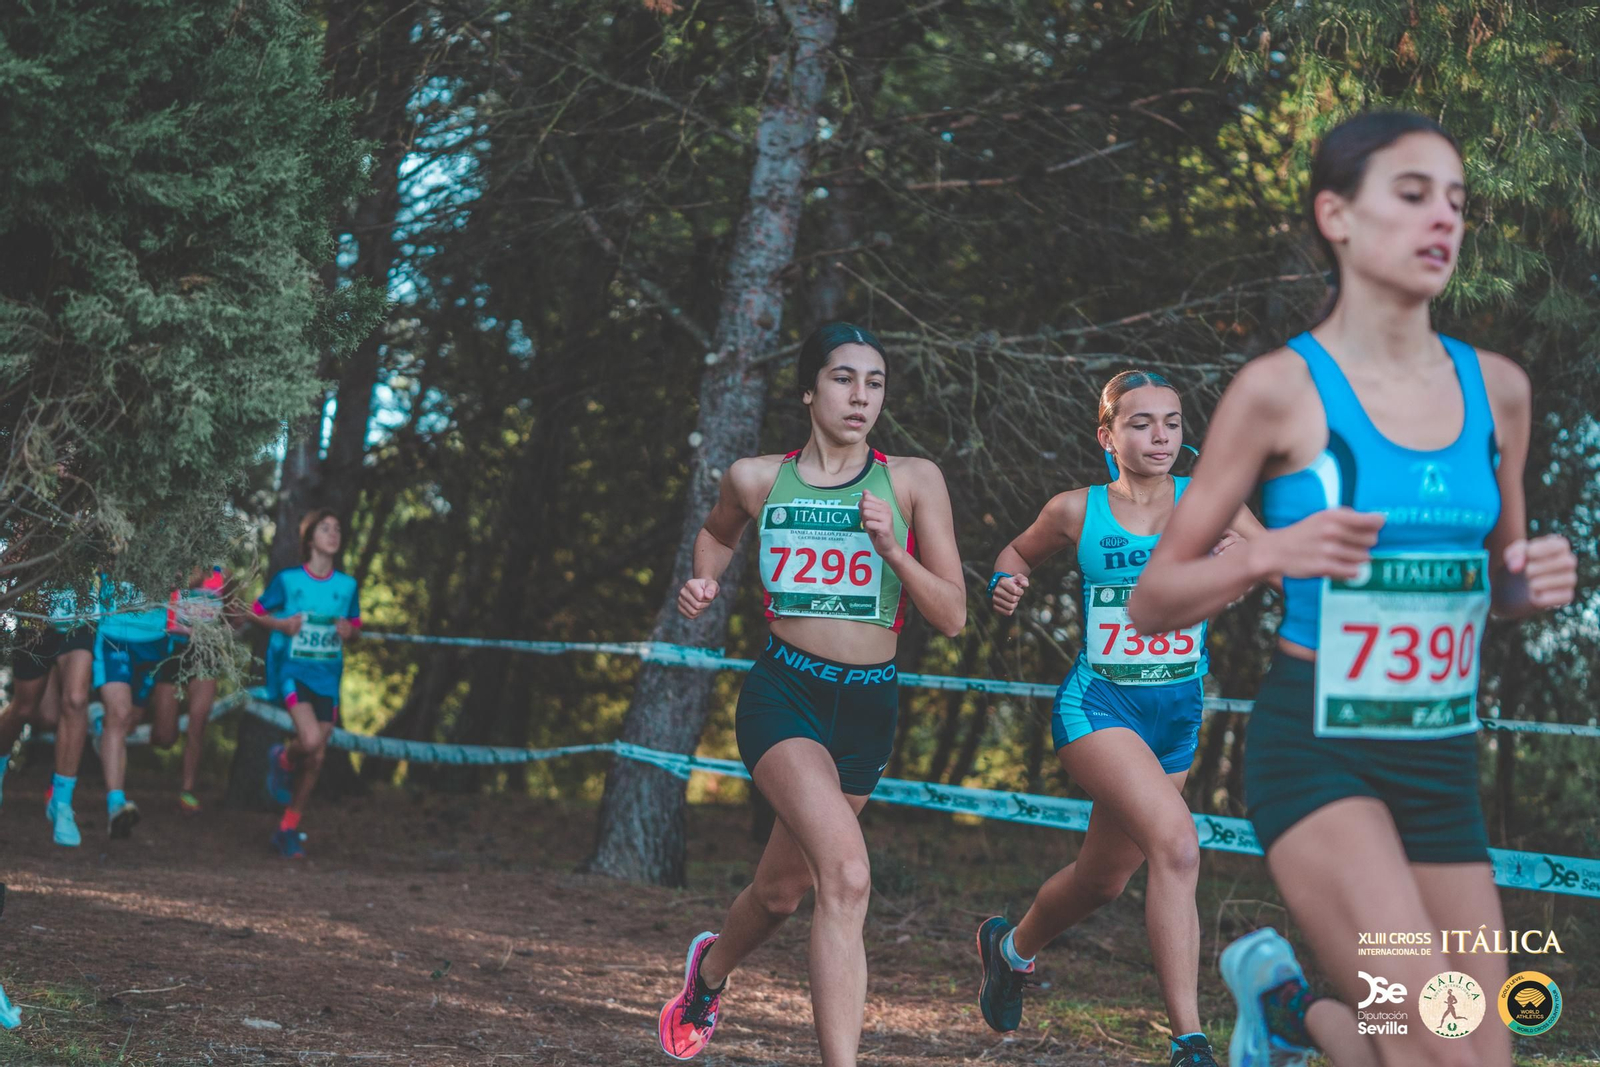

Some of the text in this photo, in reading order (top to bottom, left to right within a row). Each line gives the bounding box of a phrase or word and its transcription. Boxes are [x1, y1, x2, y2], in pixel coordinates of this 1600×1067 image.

[794, 508, 852, 524] ITÁLICA
[1101, 537, 1128, 547] TROPS
[770, 547, 873, 587] 7296
[1103, 549, 1154, 570] ne
[1099, 623, 1194, 656] 7385
[1341, 623, 1475, 683] 7390
[774, 645, 896, 685] NIKE PRO
